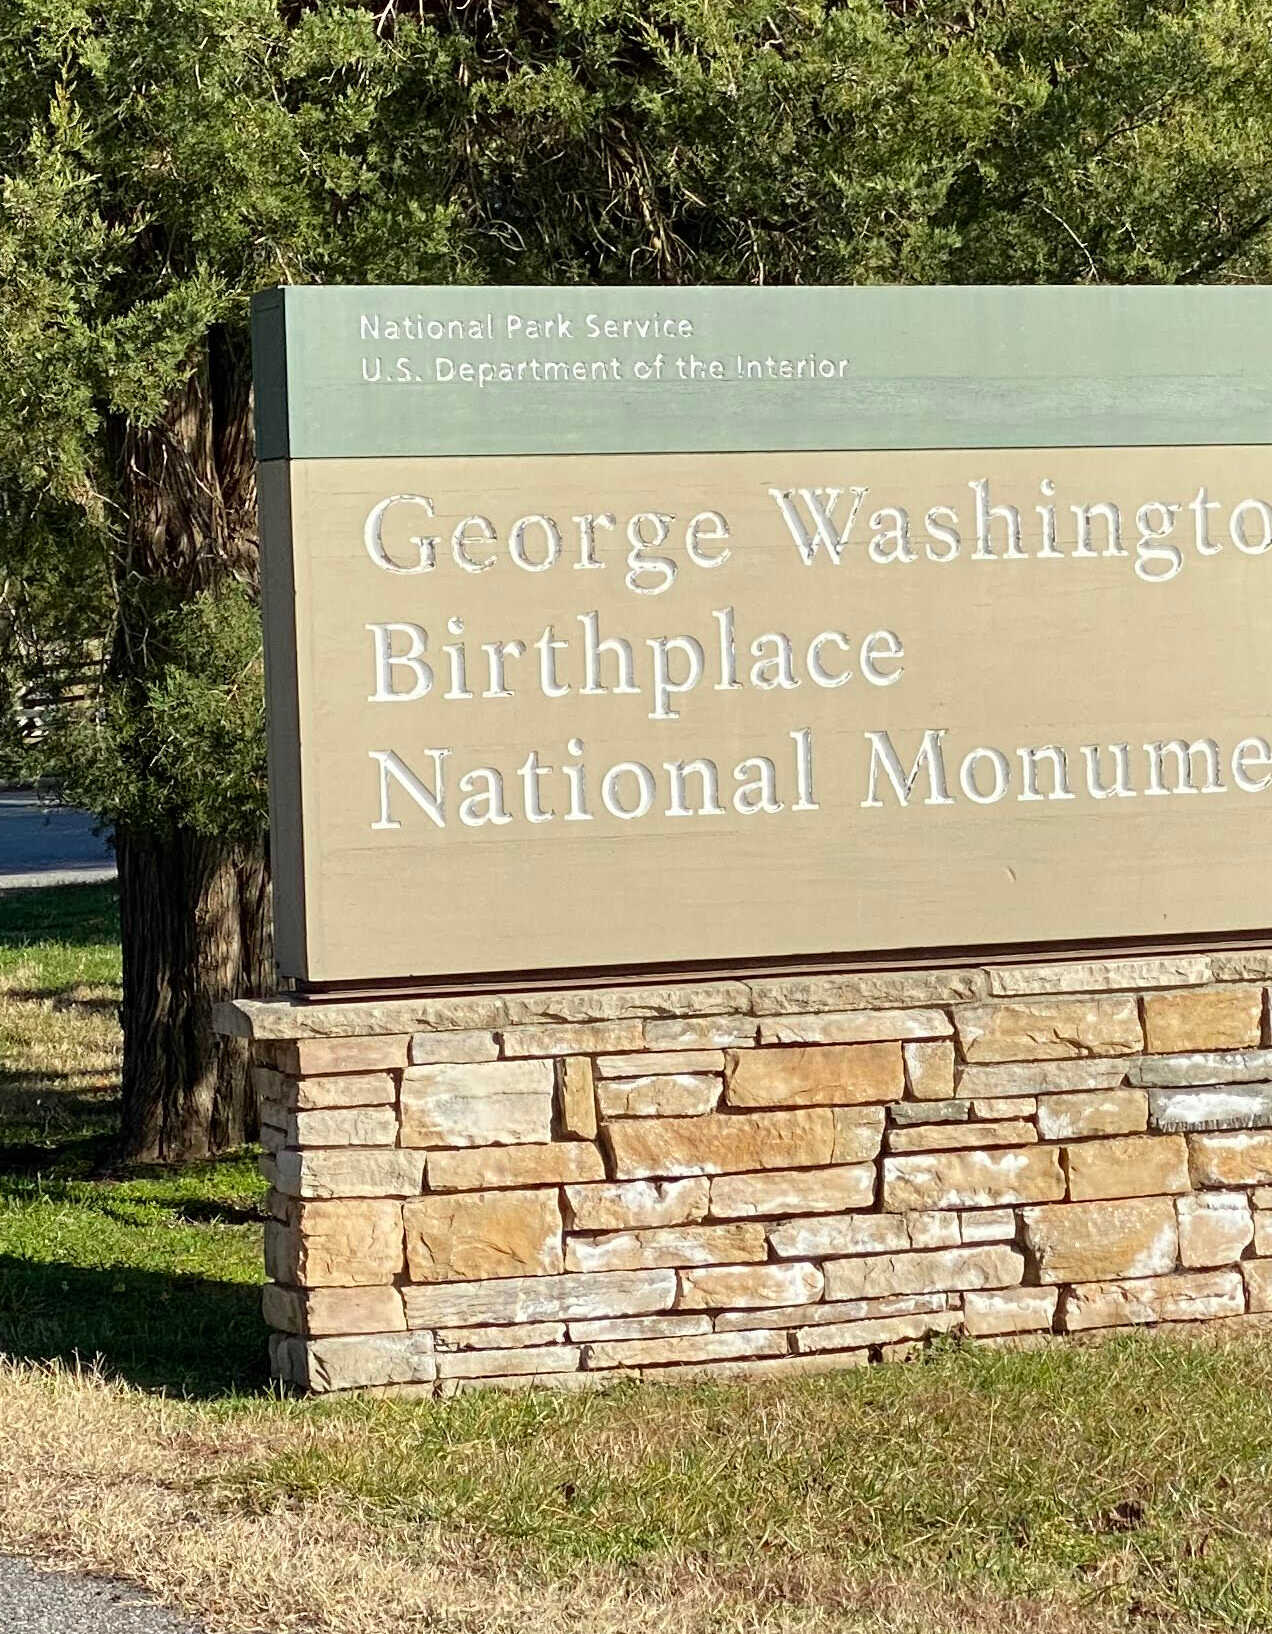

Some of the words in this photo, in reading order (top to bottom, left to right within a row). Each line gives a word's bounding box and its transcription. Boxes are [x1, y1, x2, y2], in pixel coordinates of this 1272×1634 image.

[360, 314, 493, 339] National
[507, 313, 574, 338] Park
[586, 312, 695, 337] Service
[361, 358, 422, 383] U.S.
[435, 357, 622, 387] Department
[633, 356, 664, 379] of
[676, 356, 725, 379] the
[737, 354, 850, 379] Interior
[363, 493, 731, 595] George
[365, 607, 905, 720] Birthplace
[369, 727, 820, 830] National
